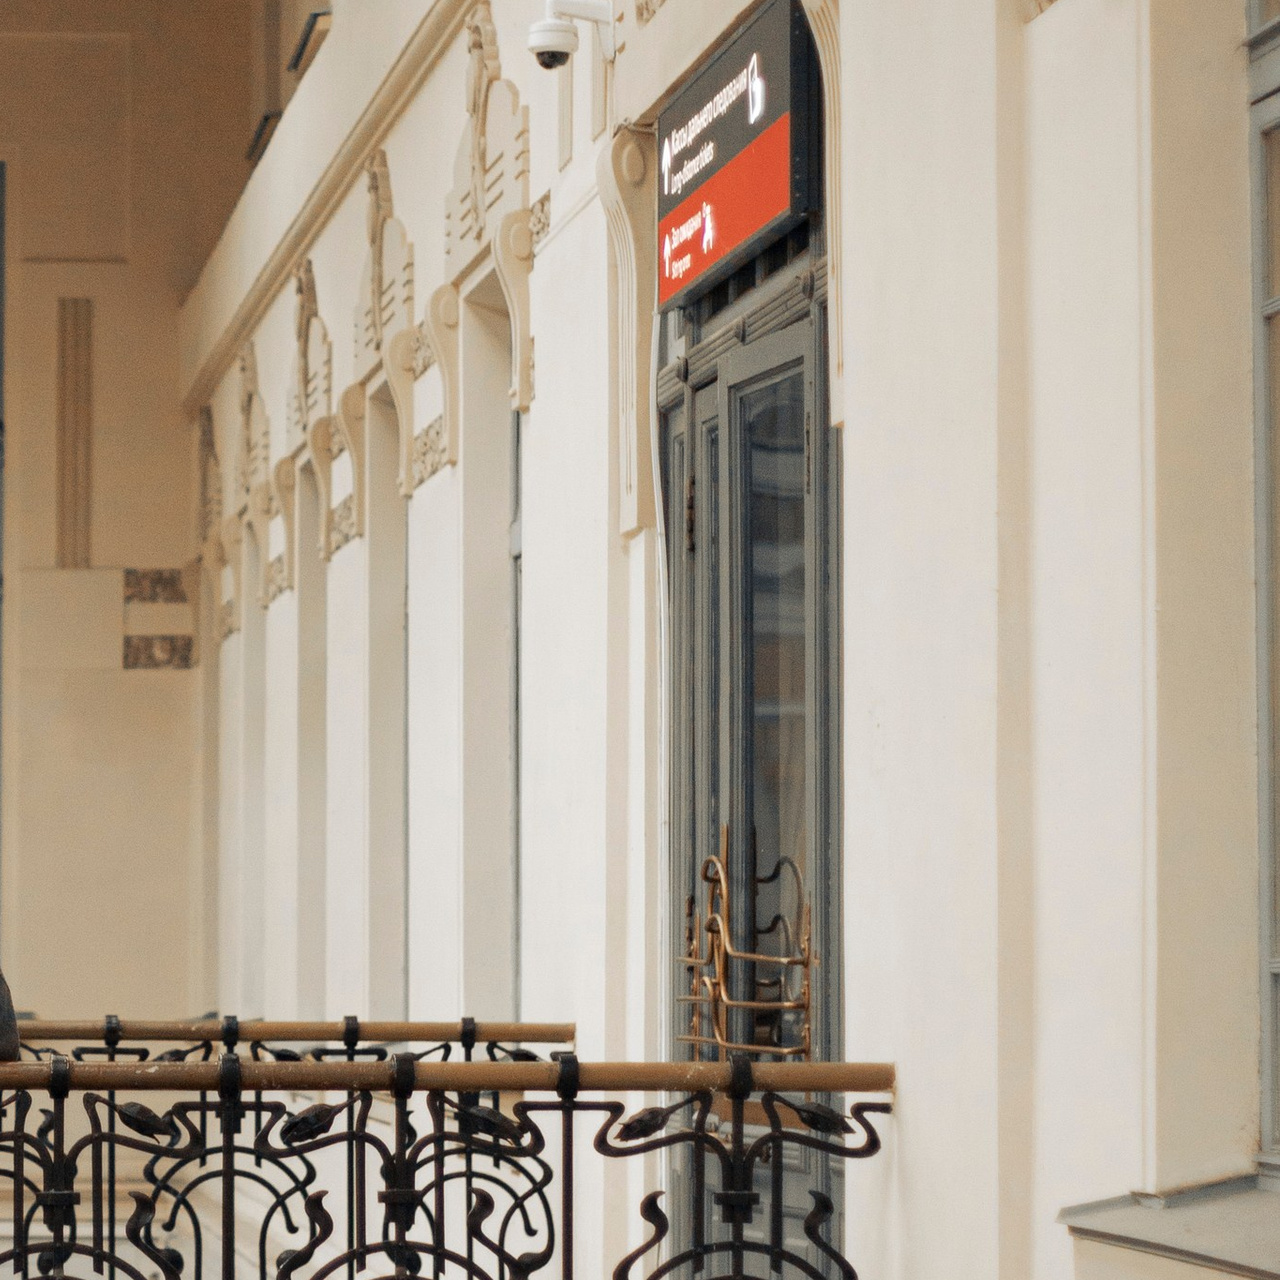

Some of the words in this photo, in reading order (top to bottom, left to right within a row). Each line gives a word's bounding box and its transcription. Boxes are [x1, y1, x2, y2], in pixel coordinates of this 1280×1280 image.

[671, 126, 687, 157] Кассы
[687, 101, 712, 147] дальнего
[713, 68, 747, 118] следования
